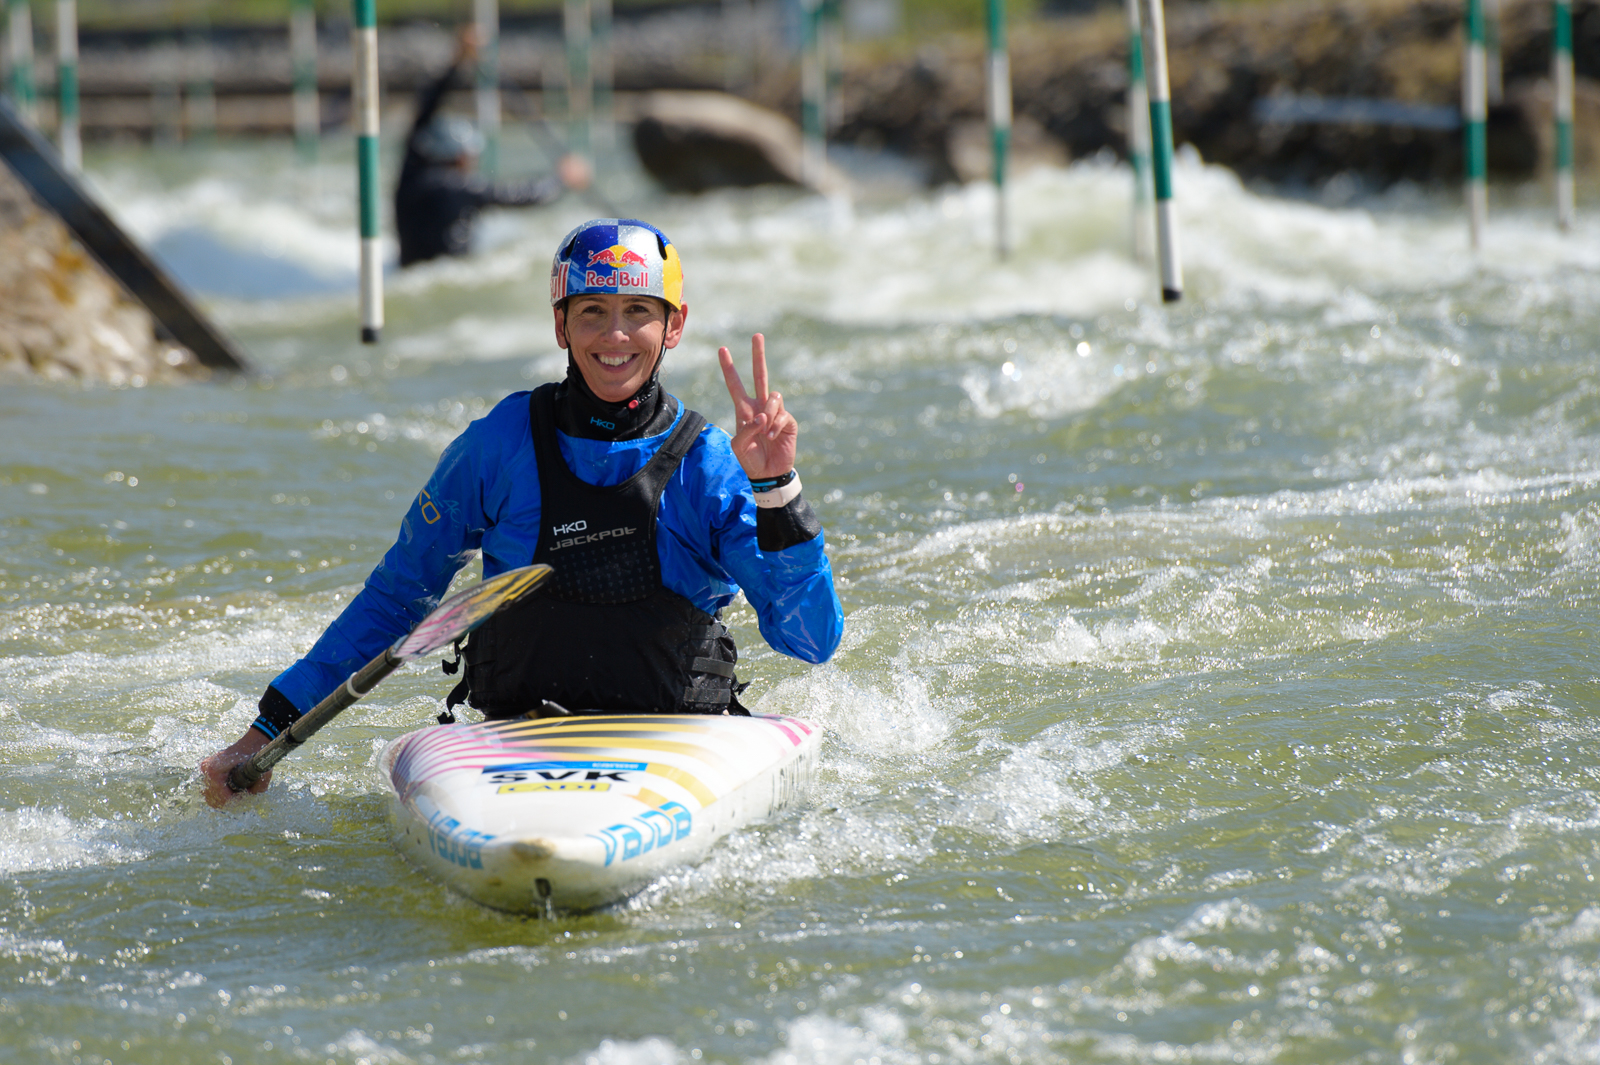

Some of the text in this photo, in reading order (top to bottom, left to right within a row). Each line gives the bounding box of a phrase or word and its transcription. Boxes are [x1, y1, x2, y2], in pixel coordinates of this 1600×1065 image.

[550, 263, 569, 299] ull
[585, 270, 648, 287] Red Bull
[488, 770, 631, 784] SVK
